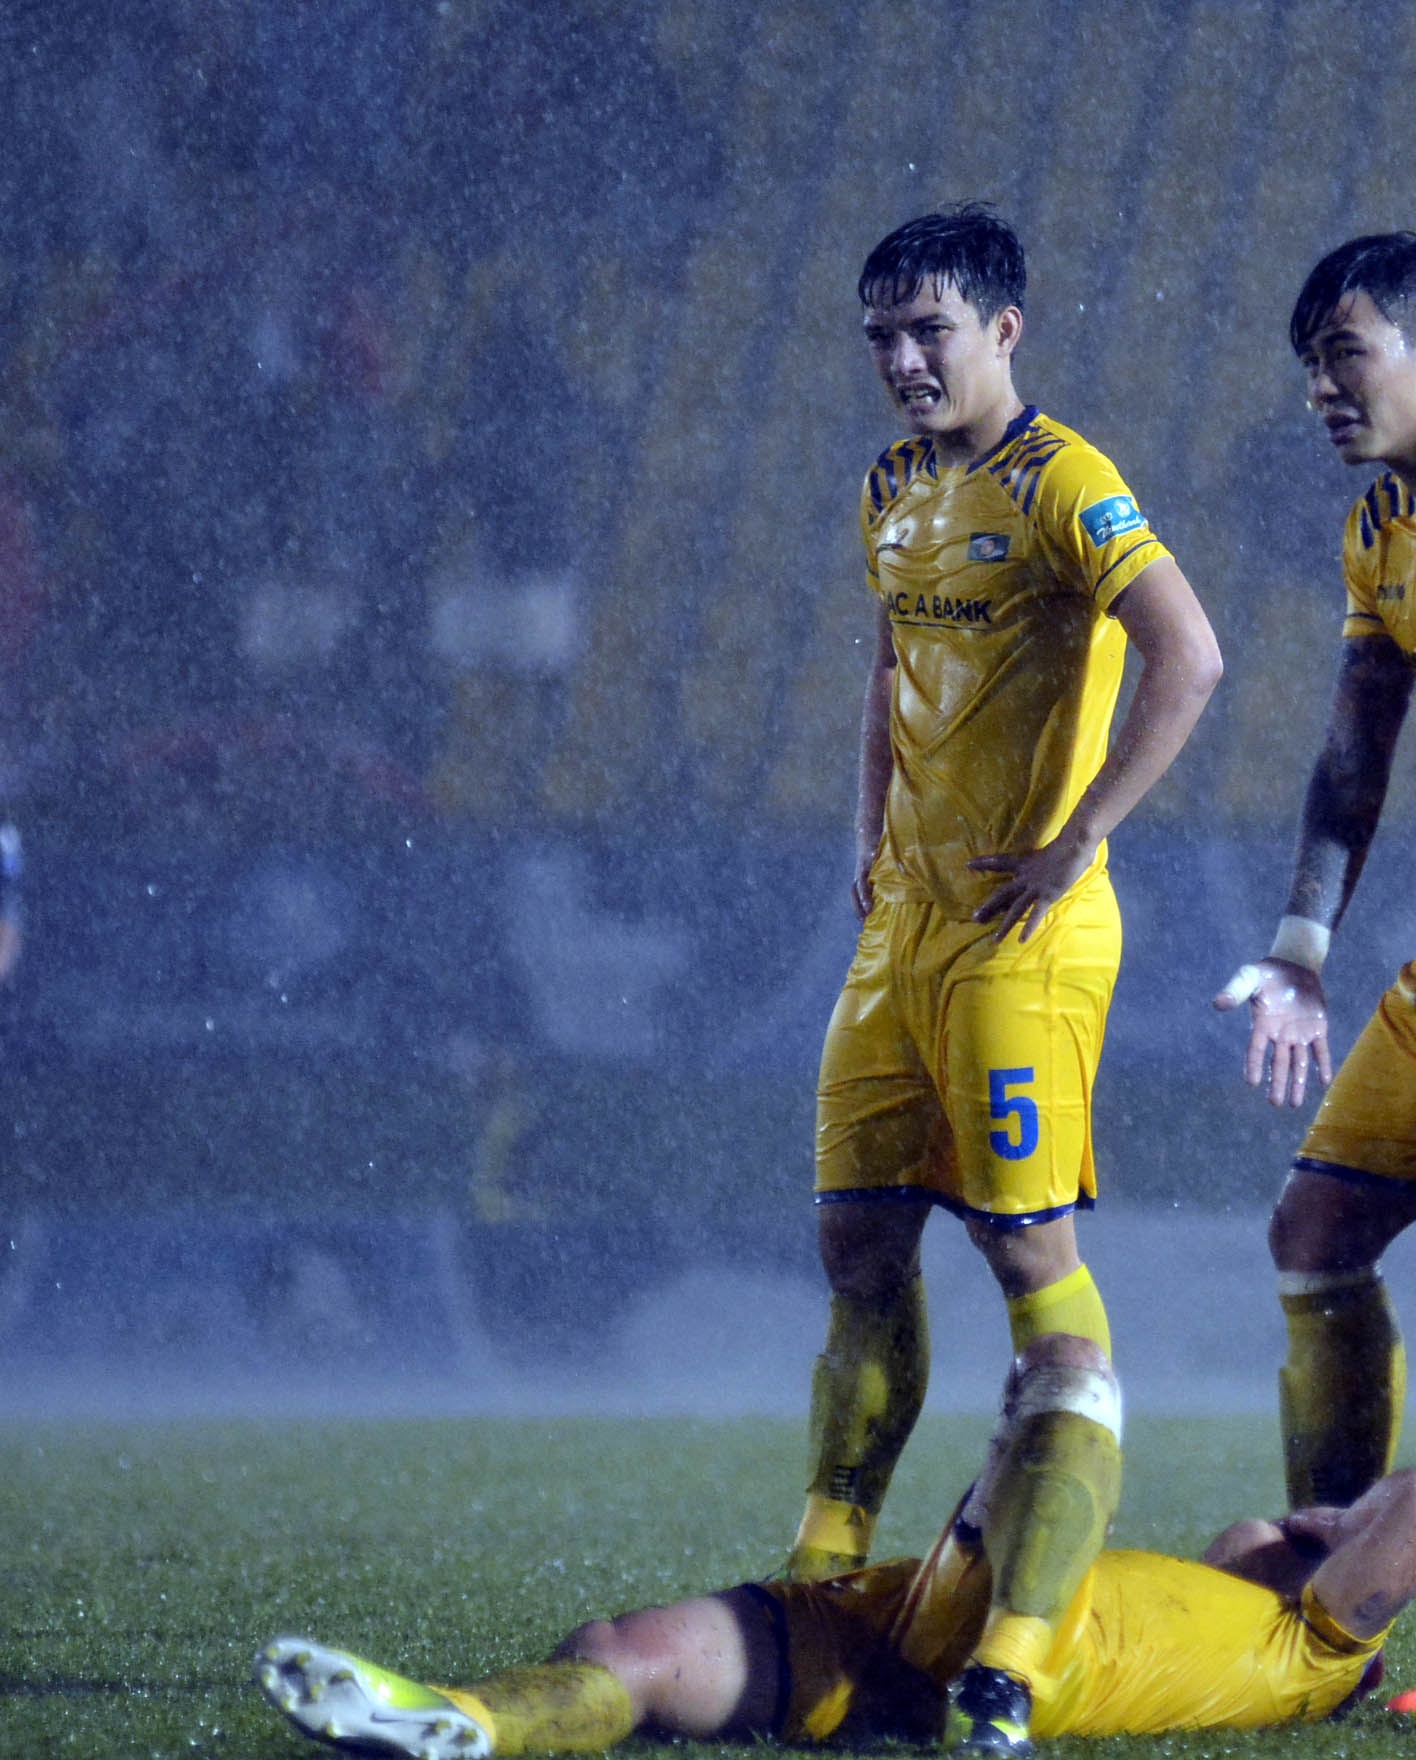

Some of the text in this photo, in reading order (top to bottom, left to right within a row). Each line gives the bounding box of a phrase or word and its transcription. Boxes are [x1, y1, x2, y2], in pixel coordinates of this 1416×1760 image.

[886, 592, 992, 624] AC A BANK
[988, 1066, 1039, 1161] 5
